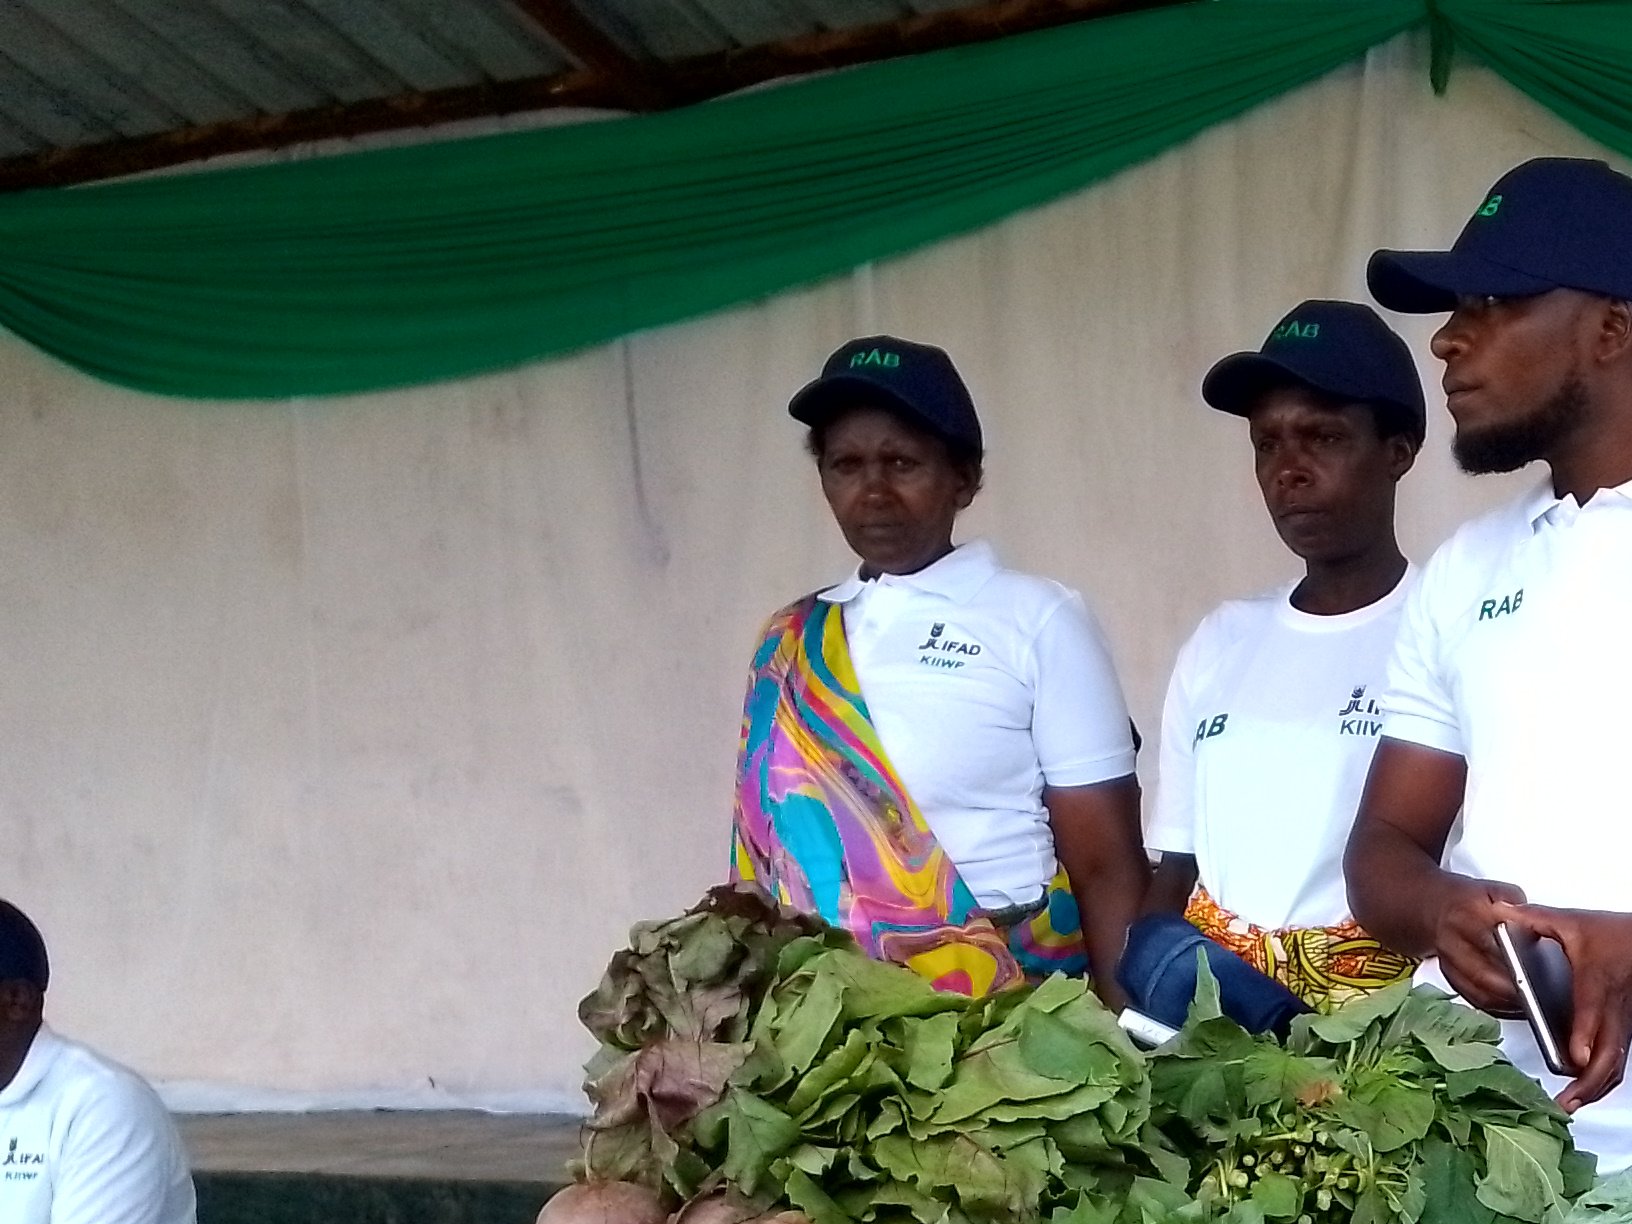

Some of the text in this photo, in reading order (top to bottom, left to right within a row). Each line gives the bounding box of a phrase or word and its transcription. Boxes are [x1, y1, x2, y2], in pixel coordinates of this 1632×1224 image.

[850, 348, 900, 368] RAB
[1479, 588, 1524, 621] RAB
[941, 640, 982, 656] IFAD
[919, 655, 966, 669] KIIWP
[1192, 713, 1229, 754] AB
